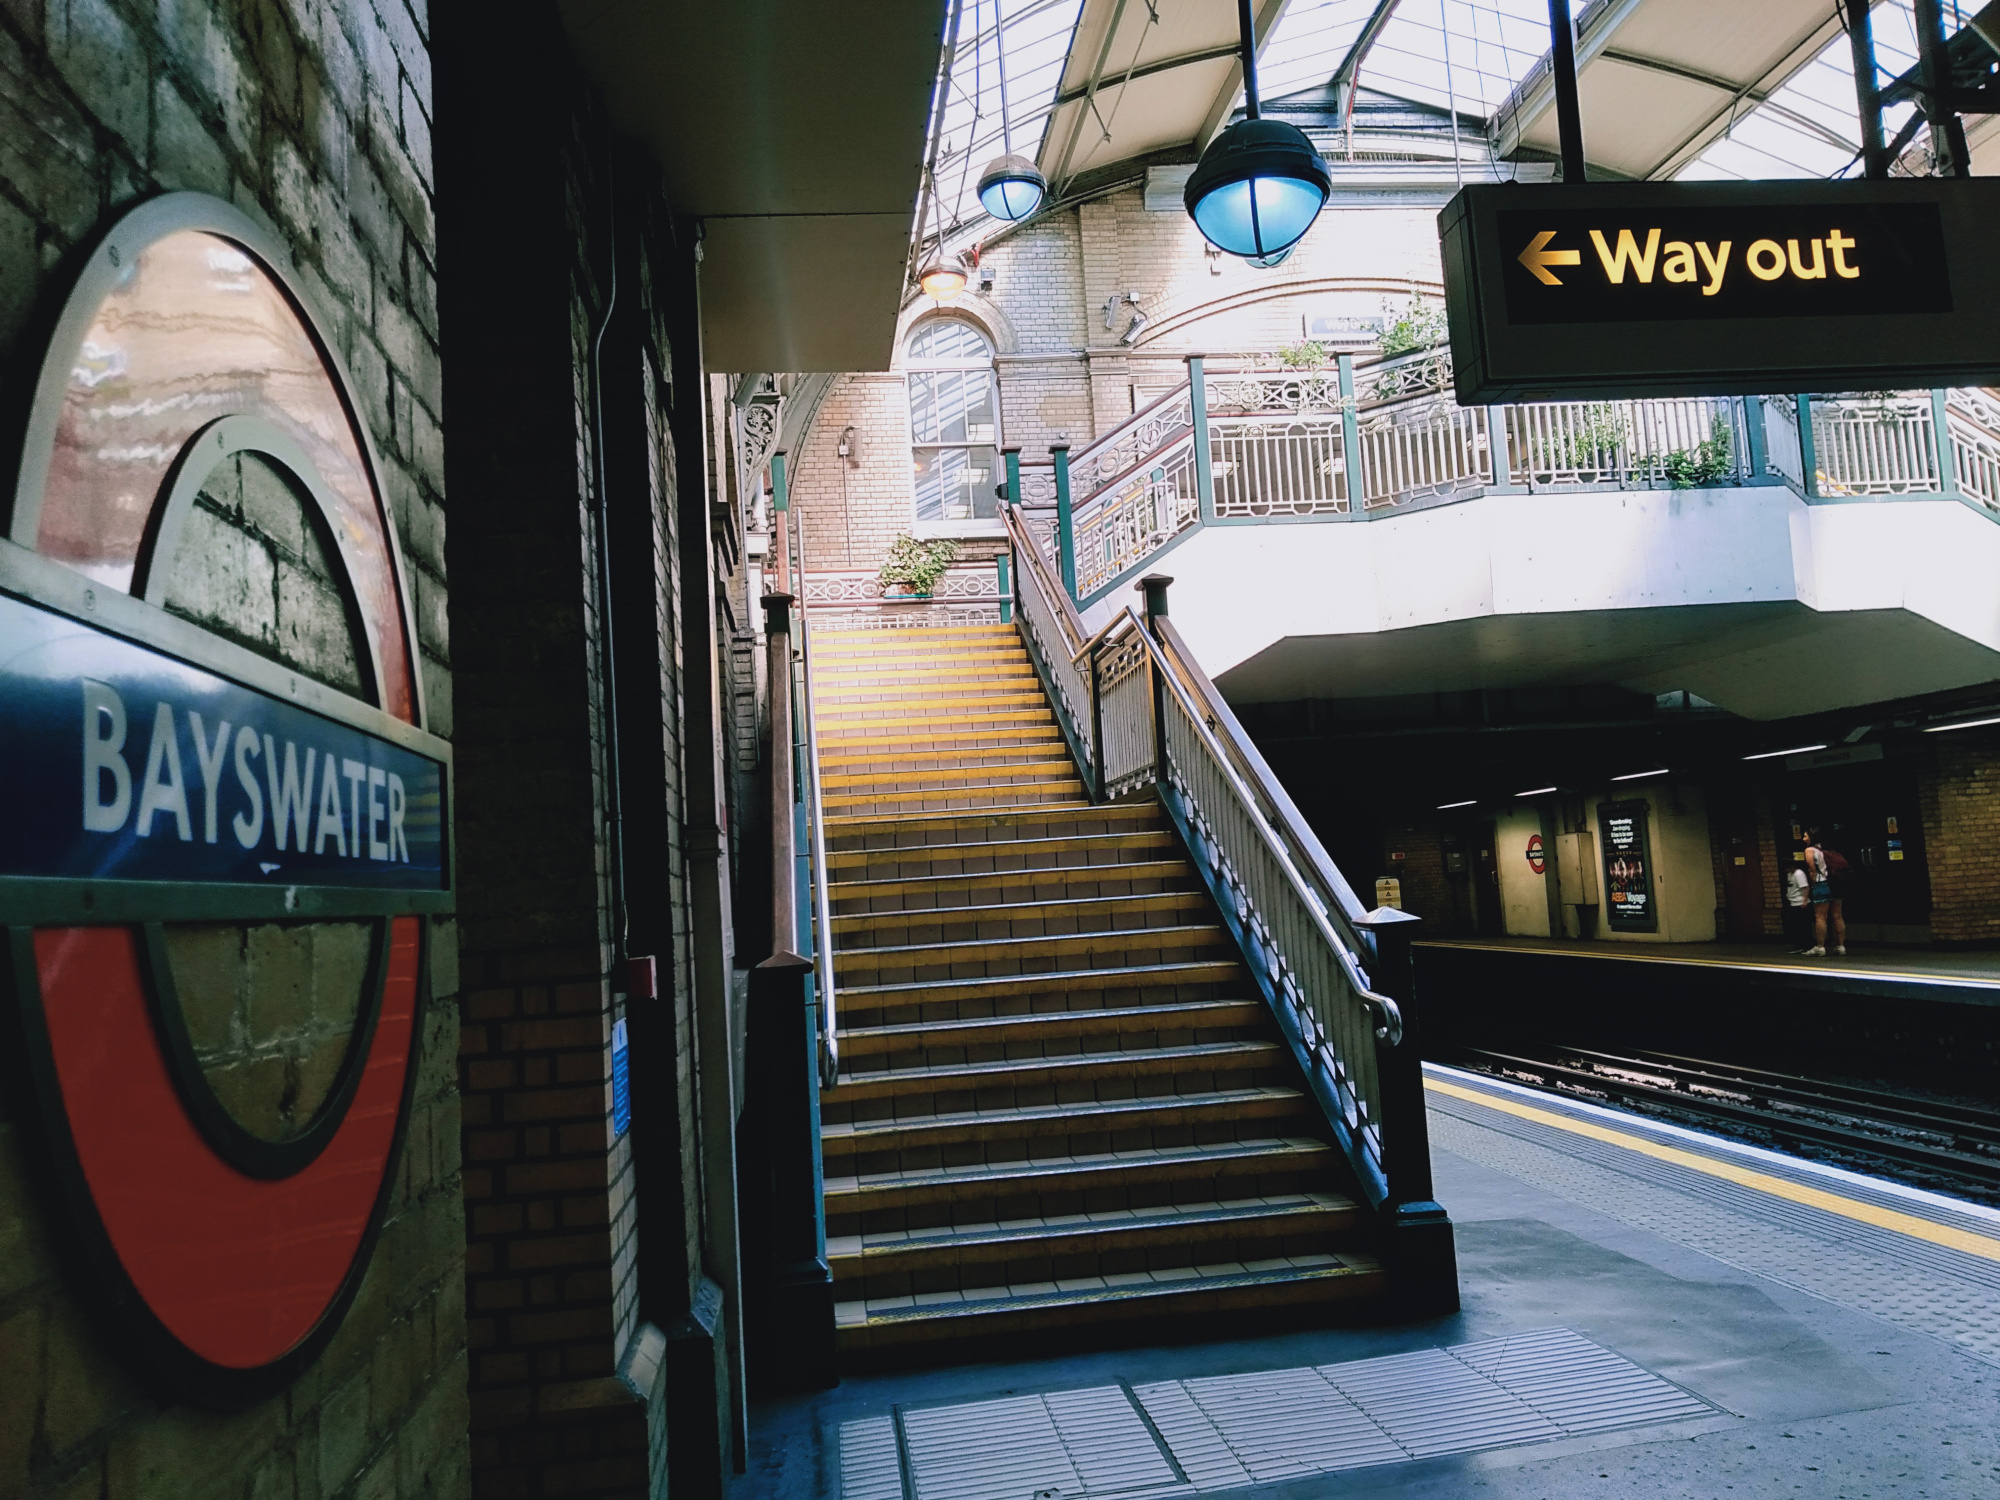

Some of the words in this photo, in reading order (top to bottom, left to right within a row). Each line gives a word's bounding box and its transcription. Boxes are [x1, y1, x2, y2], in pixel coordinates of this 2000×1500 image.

[1589, 228, 1732, 296] Way
[1746, 229, 1860, 281] out
[82, 676, 410, 864] BAYSWATER
[1612, 892, 1626, 902] ABBA
[1626, 892, 1646, 904] Voyage
